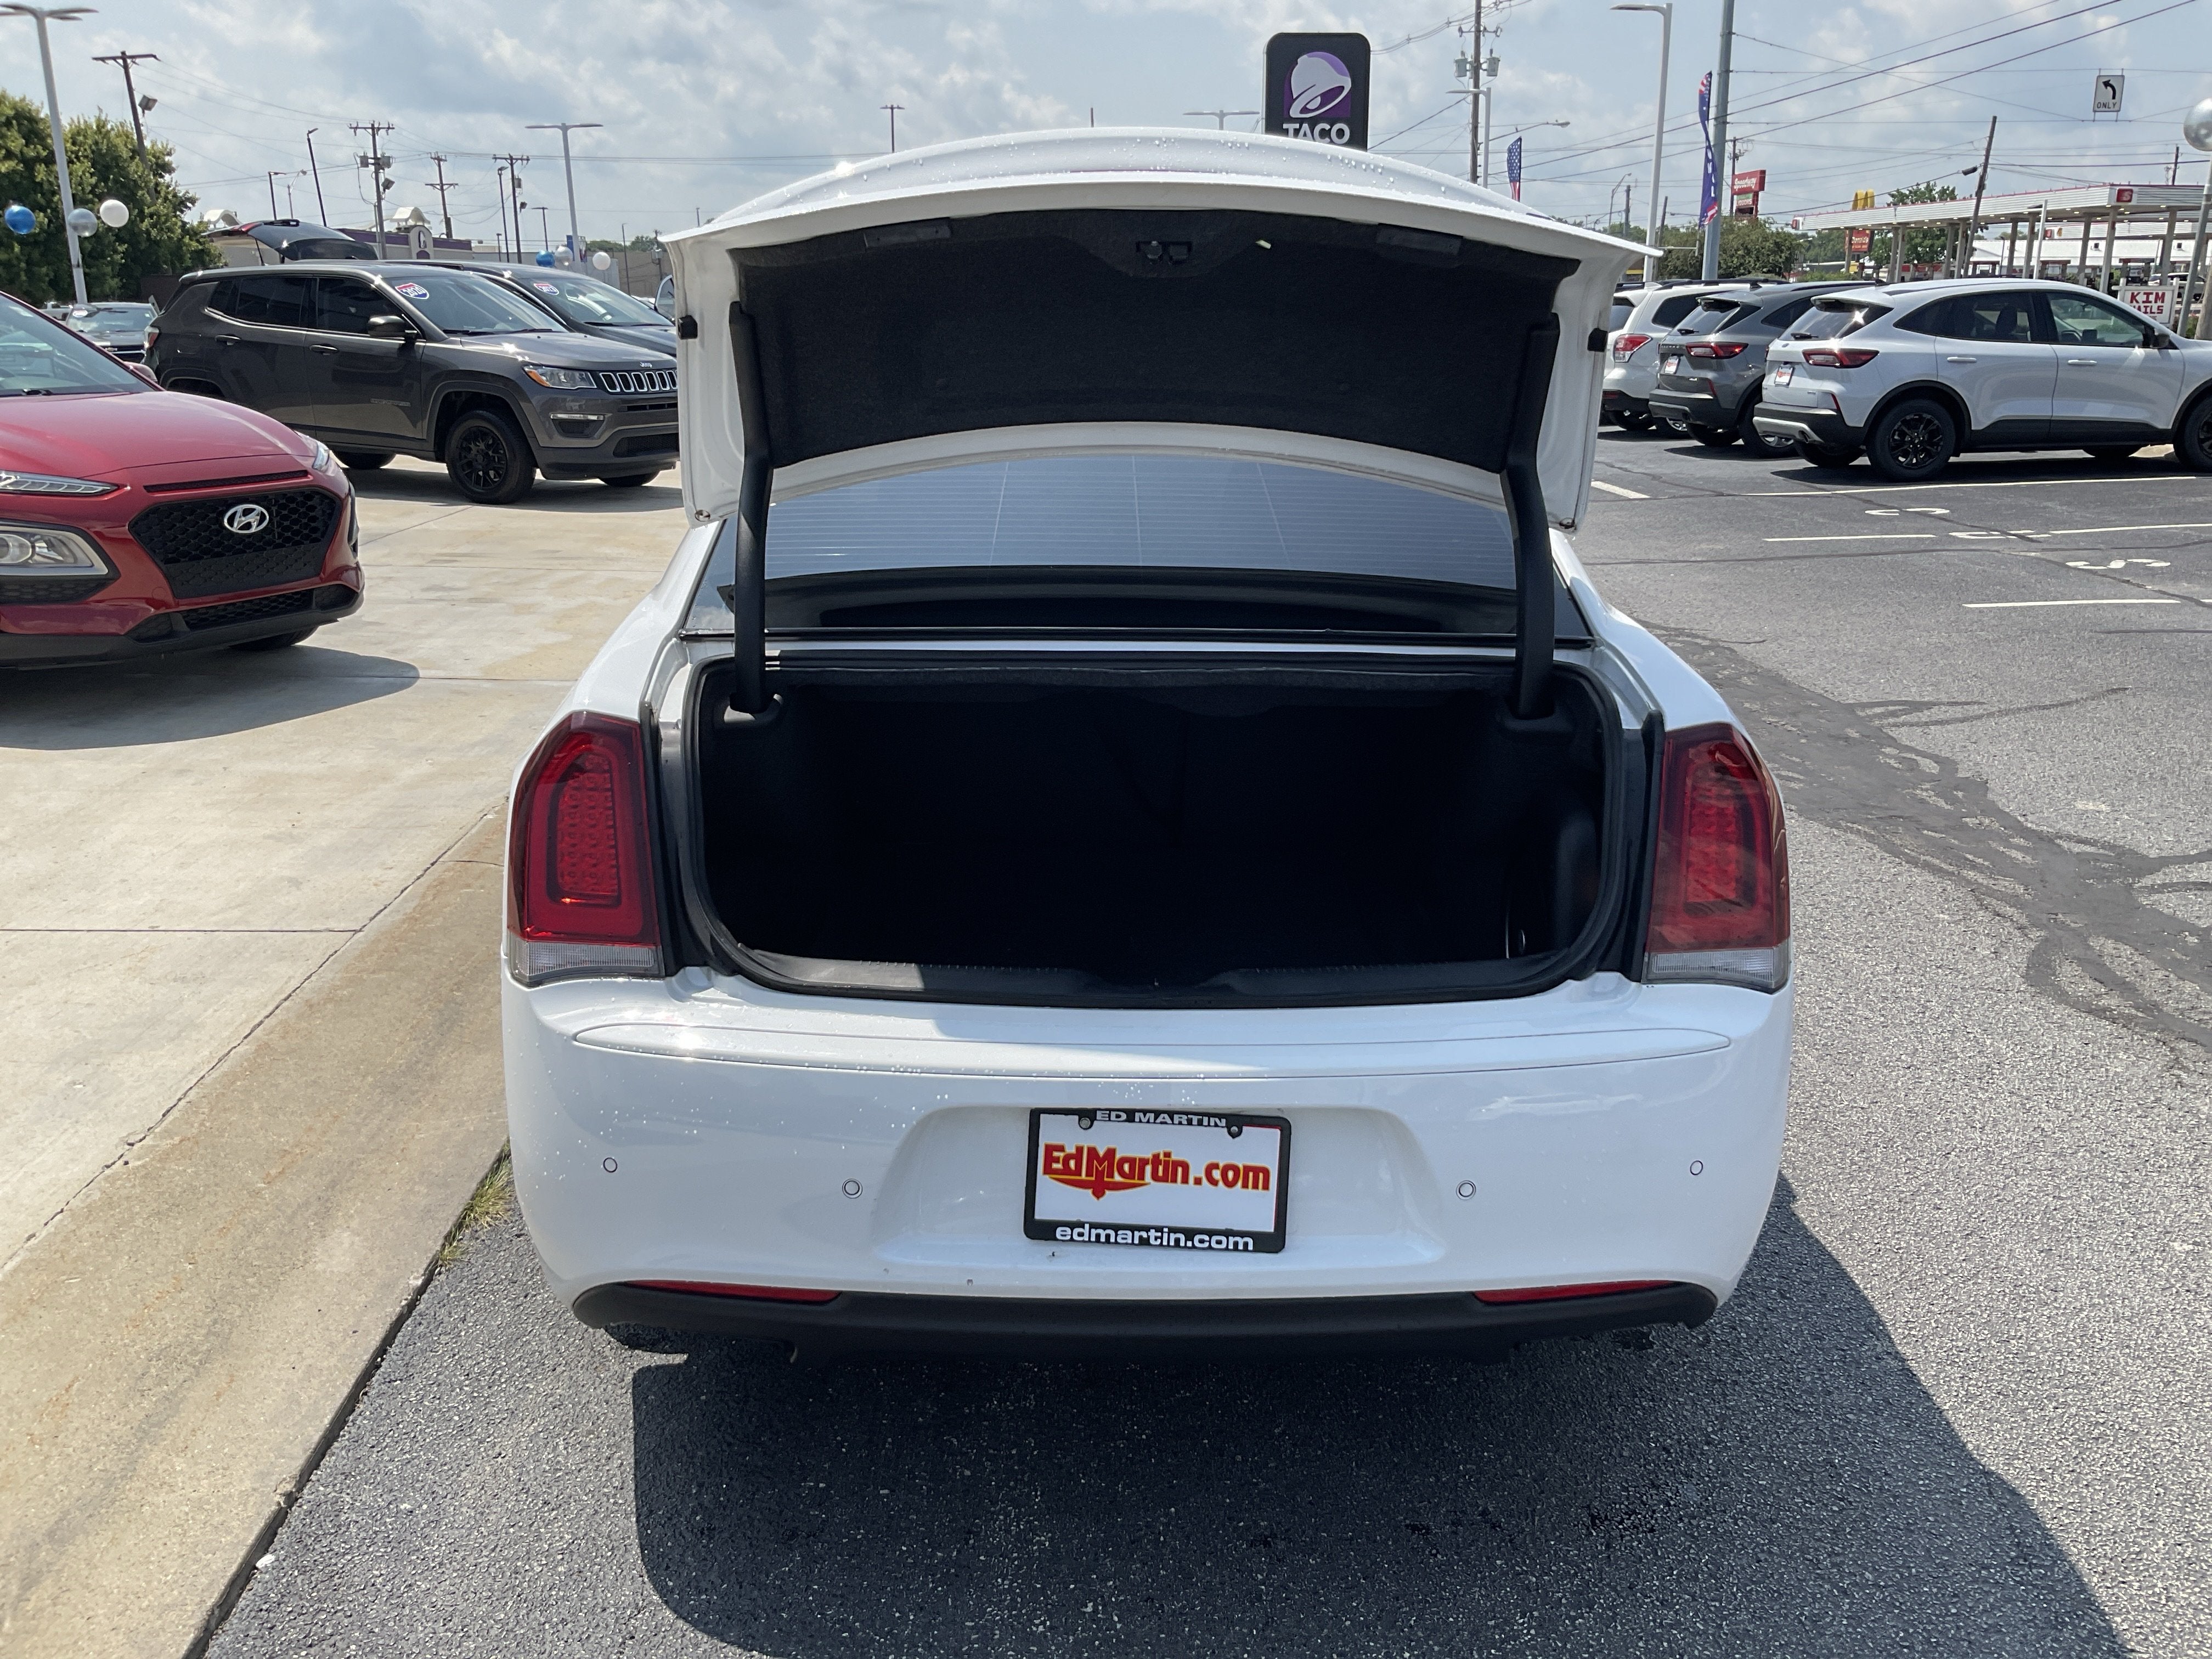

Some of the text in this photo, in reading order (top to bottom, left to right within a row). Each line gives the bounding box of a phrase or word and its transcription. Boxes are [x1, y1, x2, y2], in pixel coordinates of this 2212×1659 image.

[1283, 123, 1350, 144] TACO
[2130, 291, 2165, 303] KIM
[2130, 305, 2164, 314] AILS
[1096, 1110, 1227, 1127] ED MARTIN
[1042, 1142, 1271, 1192] EdMartin.com
[1056, 1223, 1254, 1251] edmartin.com
